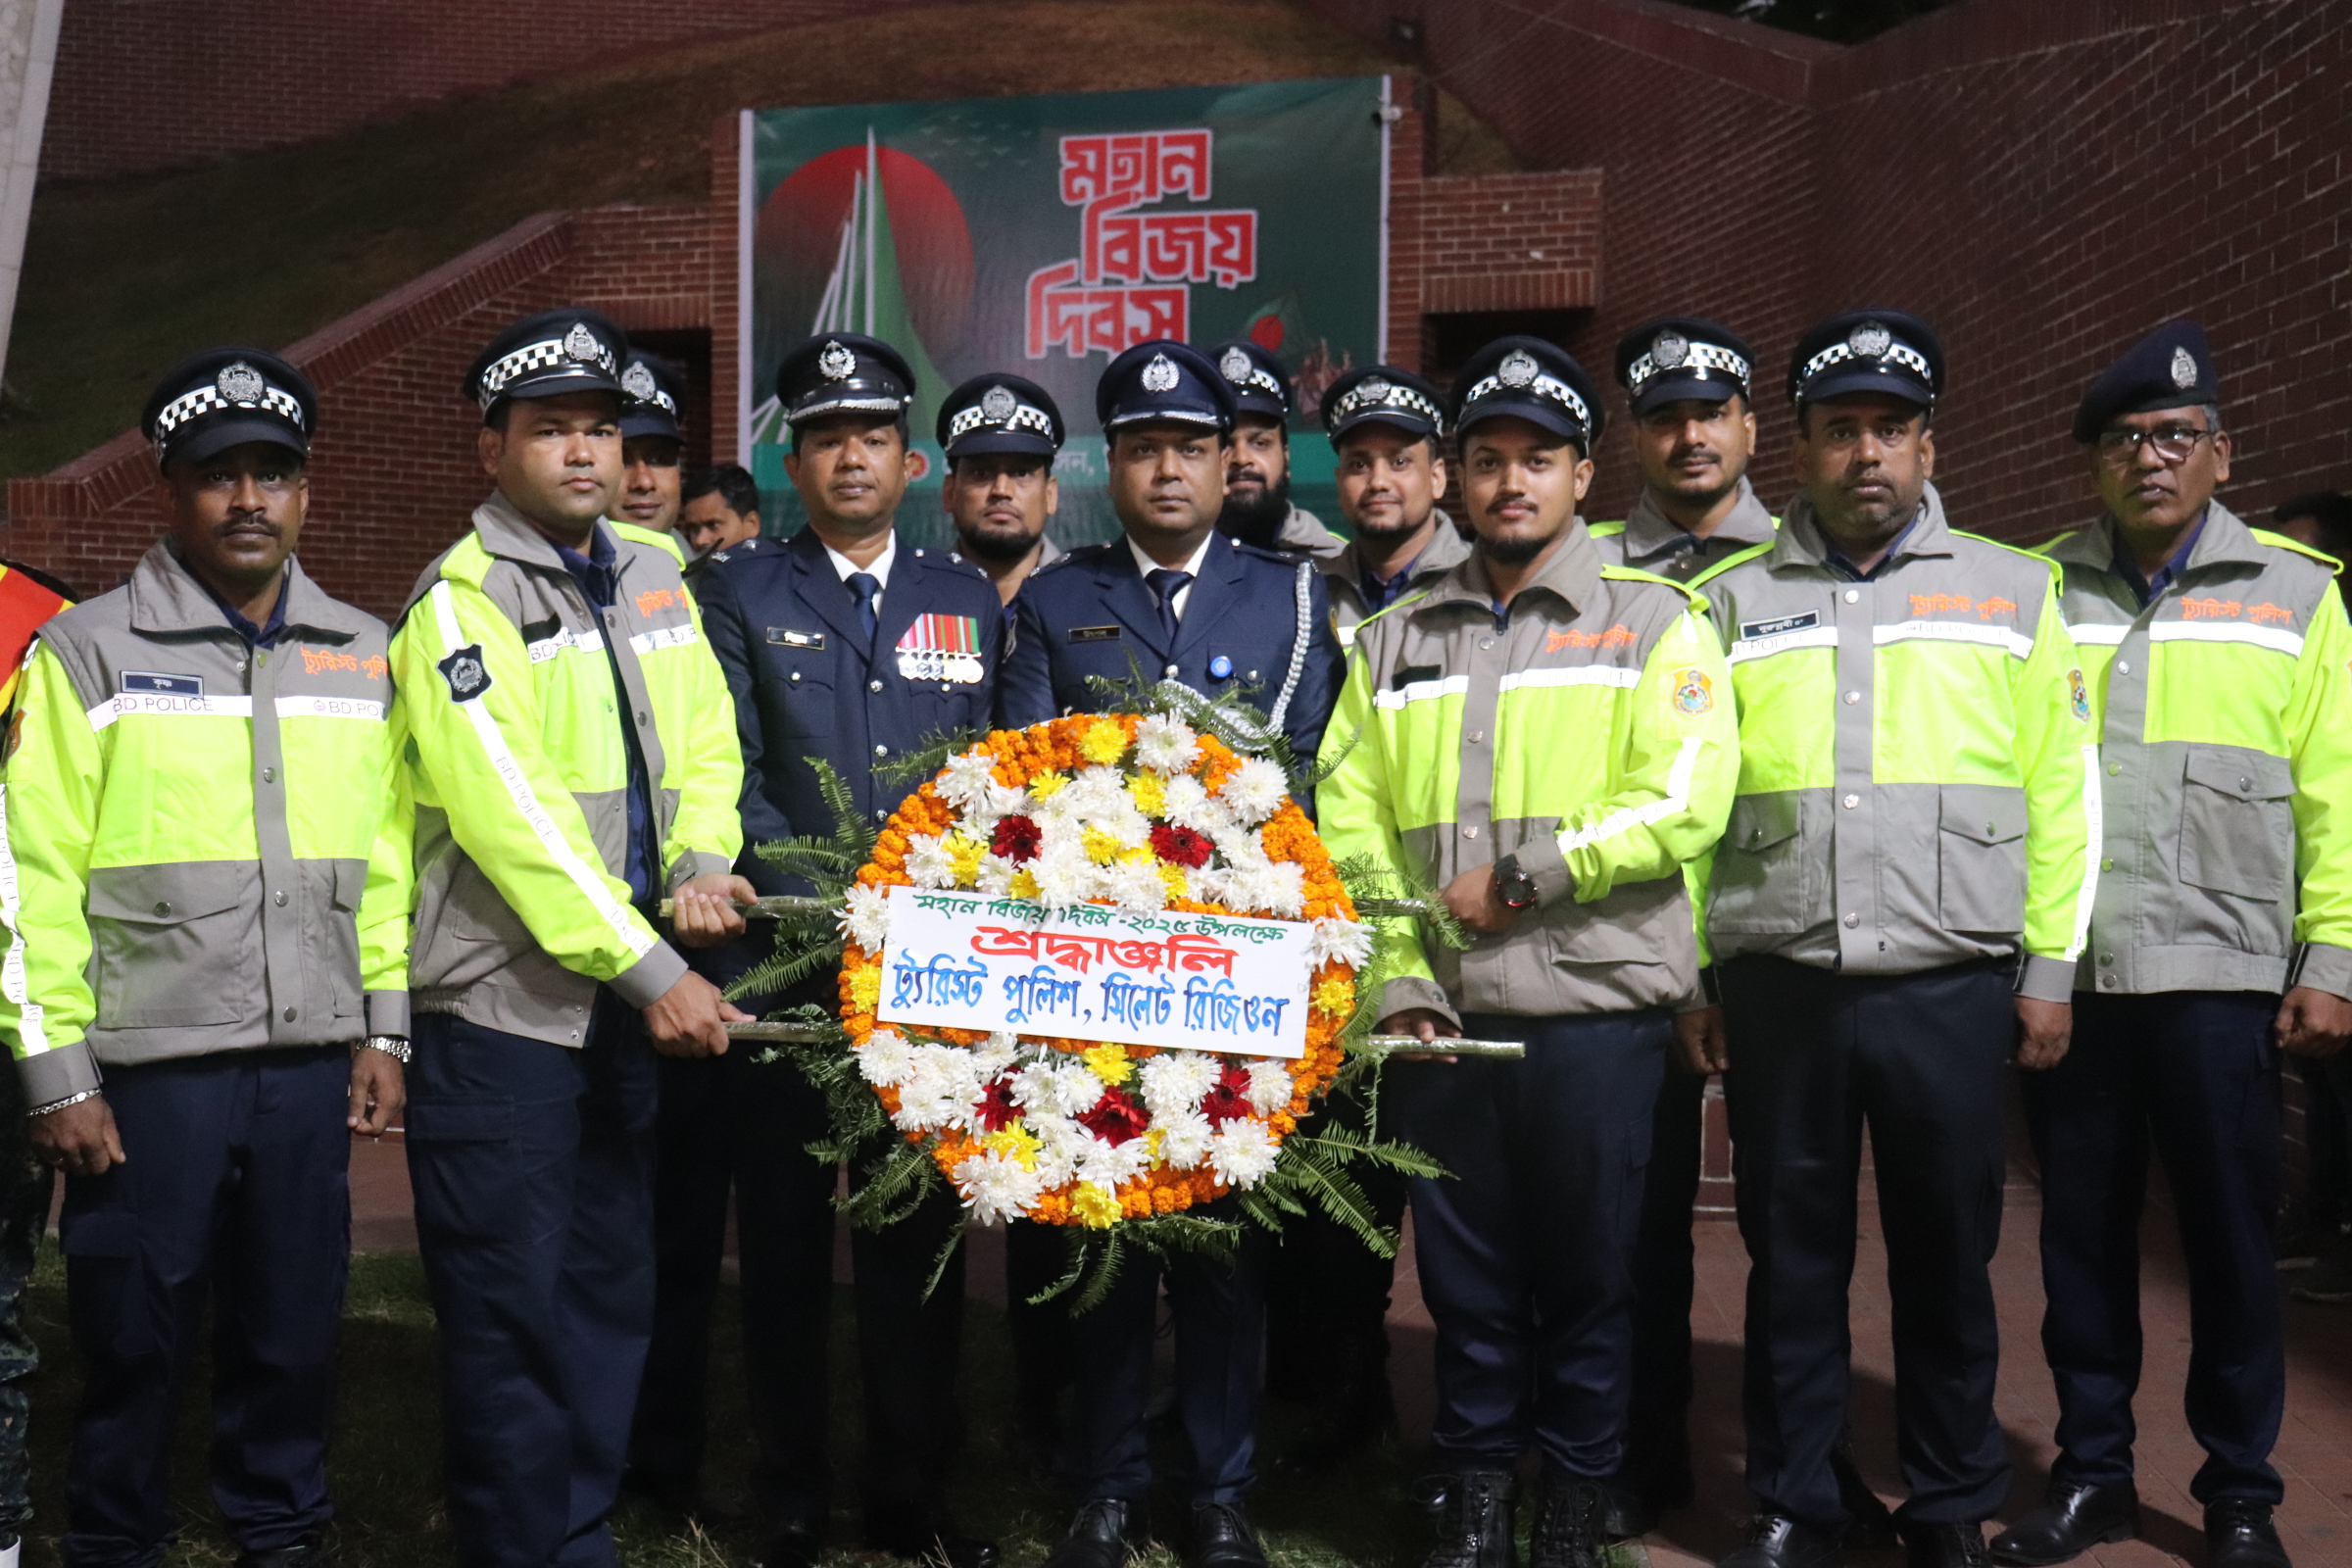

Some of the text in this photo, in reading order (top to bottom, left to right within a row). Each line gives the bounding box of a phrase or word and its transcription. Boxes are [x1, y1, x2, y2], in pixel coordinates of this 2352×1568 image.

[1061, 130, 1211, 204] মহান
[1082, 196, 1256, 287] বিজয়
[1026, 261, 1189, 358] দিবস
[2180, 597, 2294, 623] ট্যুরিস্ট পুলিশ
[300, 646, 359, 675] ট্যুরিস্ট
[145, 698, 214, 711] POLICE
[329, 701, 351, 714] BD
[496, 756, 557, 844] BD POLICE
[912, 895, 982, 919] মহান
[970, 926, 1239, 979] শ্রদ্ধাঞ্জলি
[890, 948, 989, 1009] ট্যুরিস্ট
[1101, 972, 1176, 1032] সিলেট
[1183, 975, 1291, 1037] রিজিওন
